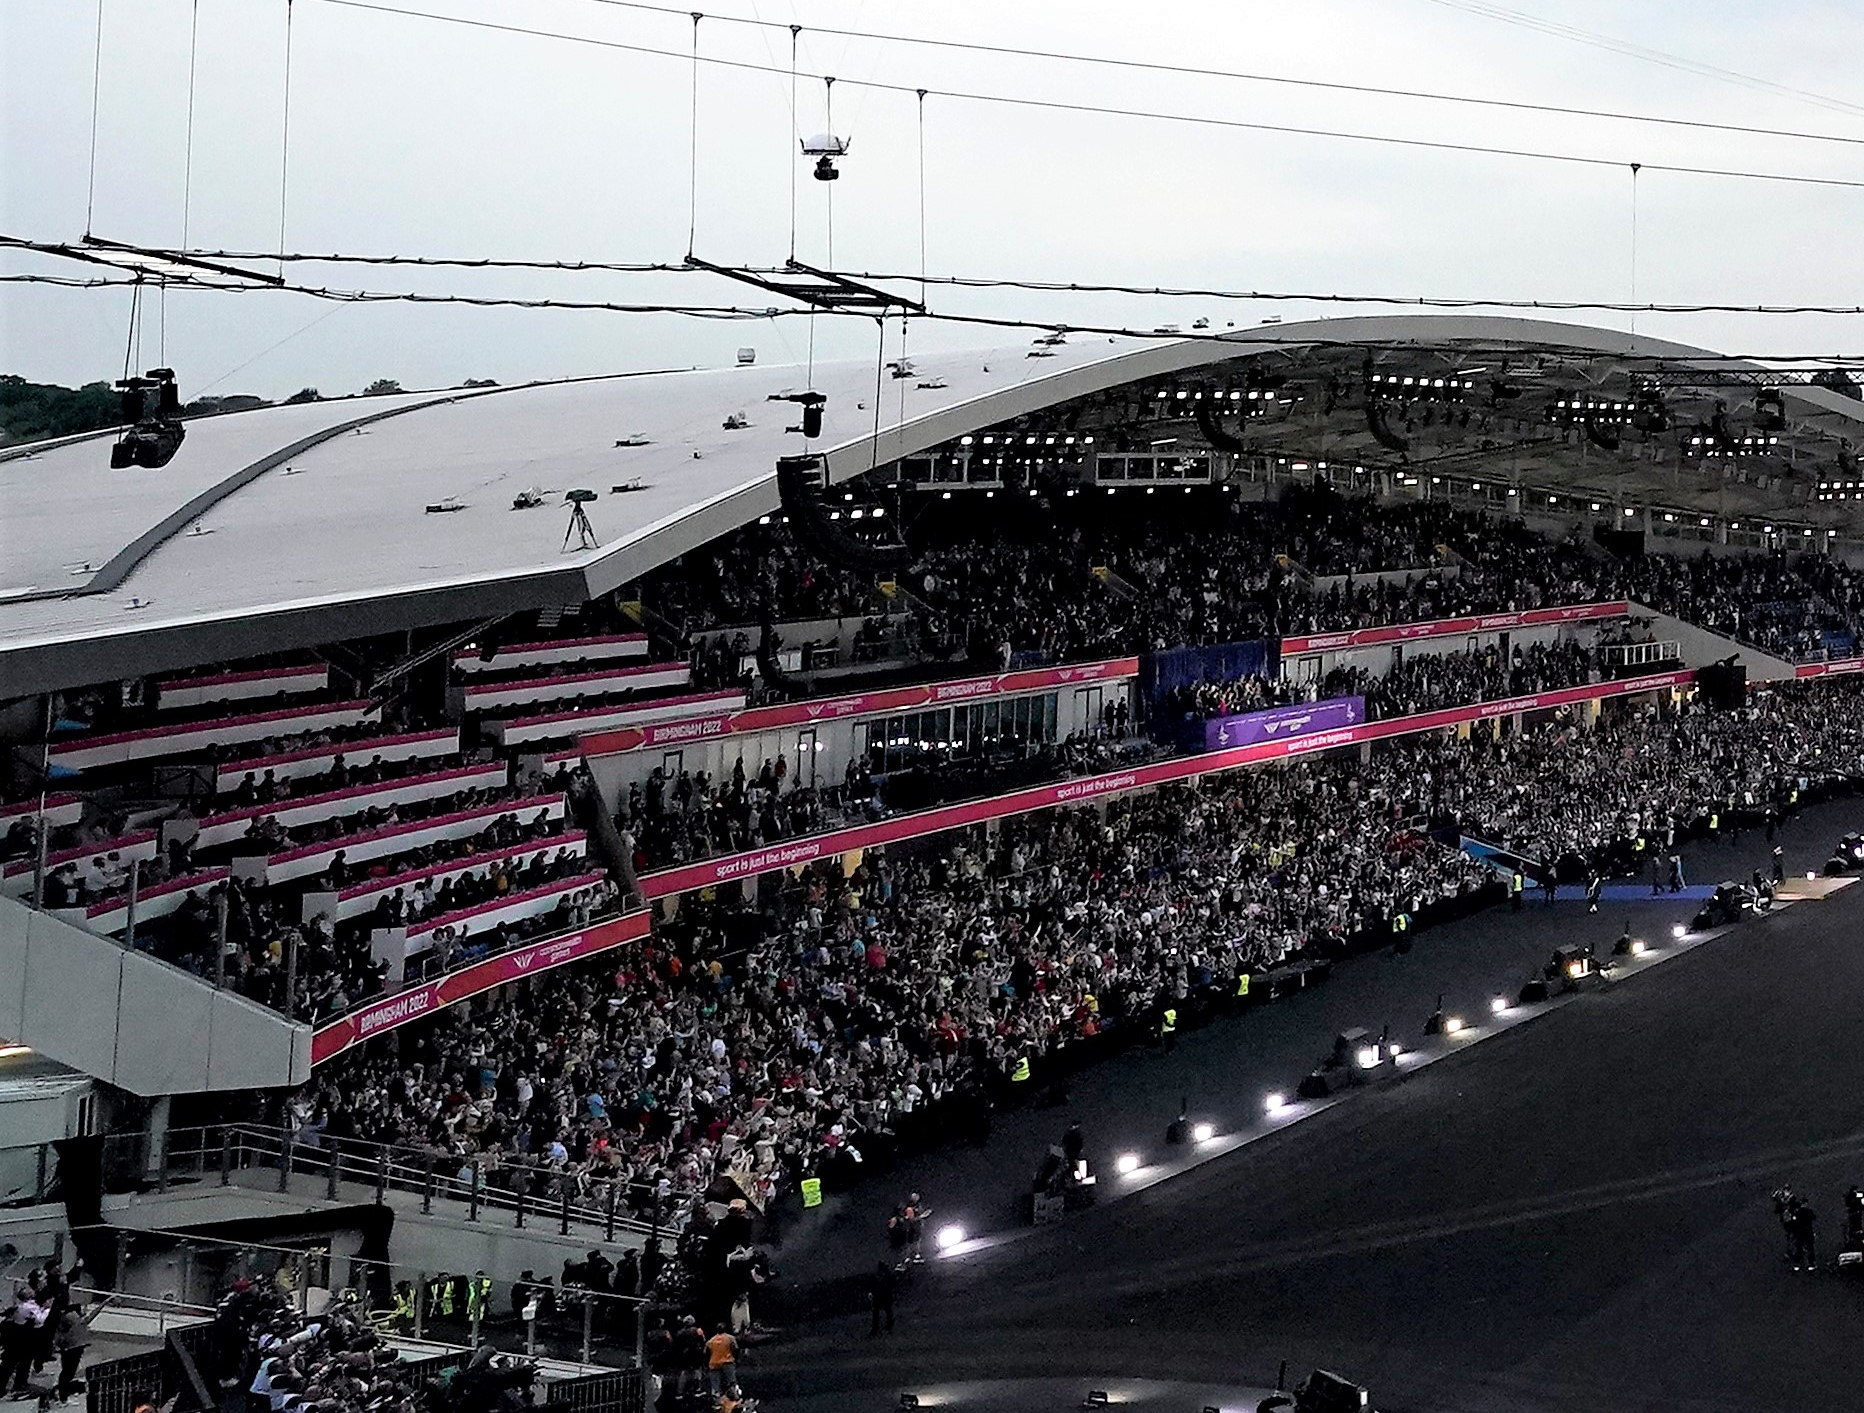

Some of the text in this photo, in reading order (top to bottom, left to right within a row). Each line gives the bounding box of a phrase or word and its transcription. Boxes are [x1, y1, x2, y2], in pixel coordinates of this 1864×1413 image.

[703, 720, 721, 735] 2022
[716, 860, 740, 878] sport
[749, 855, 765, 871] just
[781, 843, 820, 862] beginning
[361, 991, 429, 1034] BIRMINGHAM 2022
